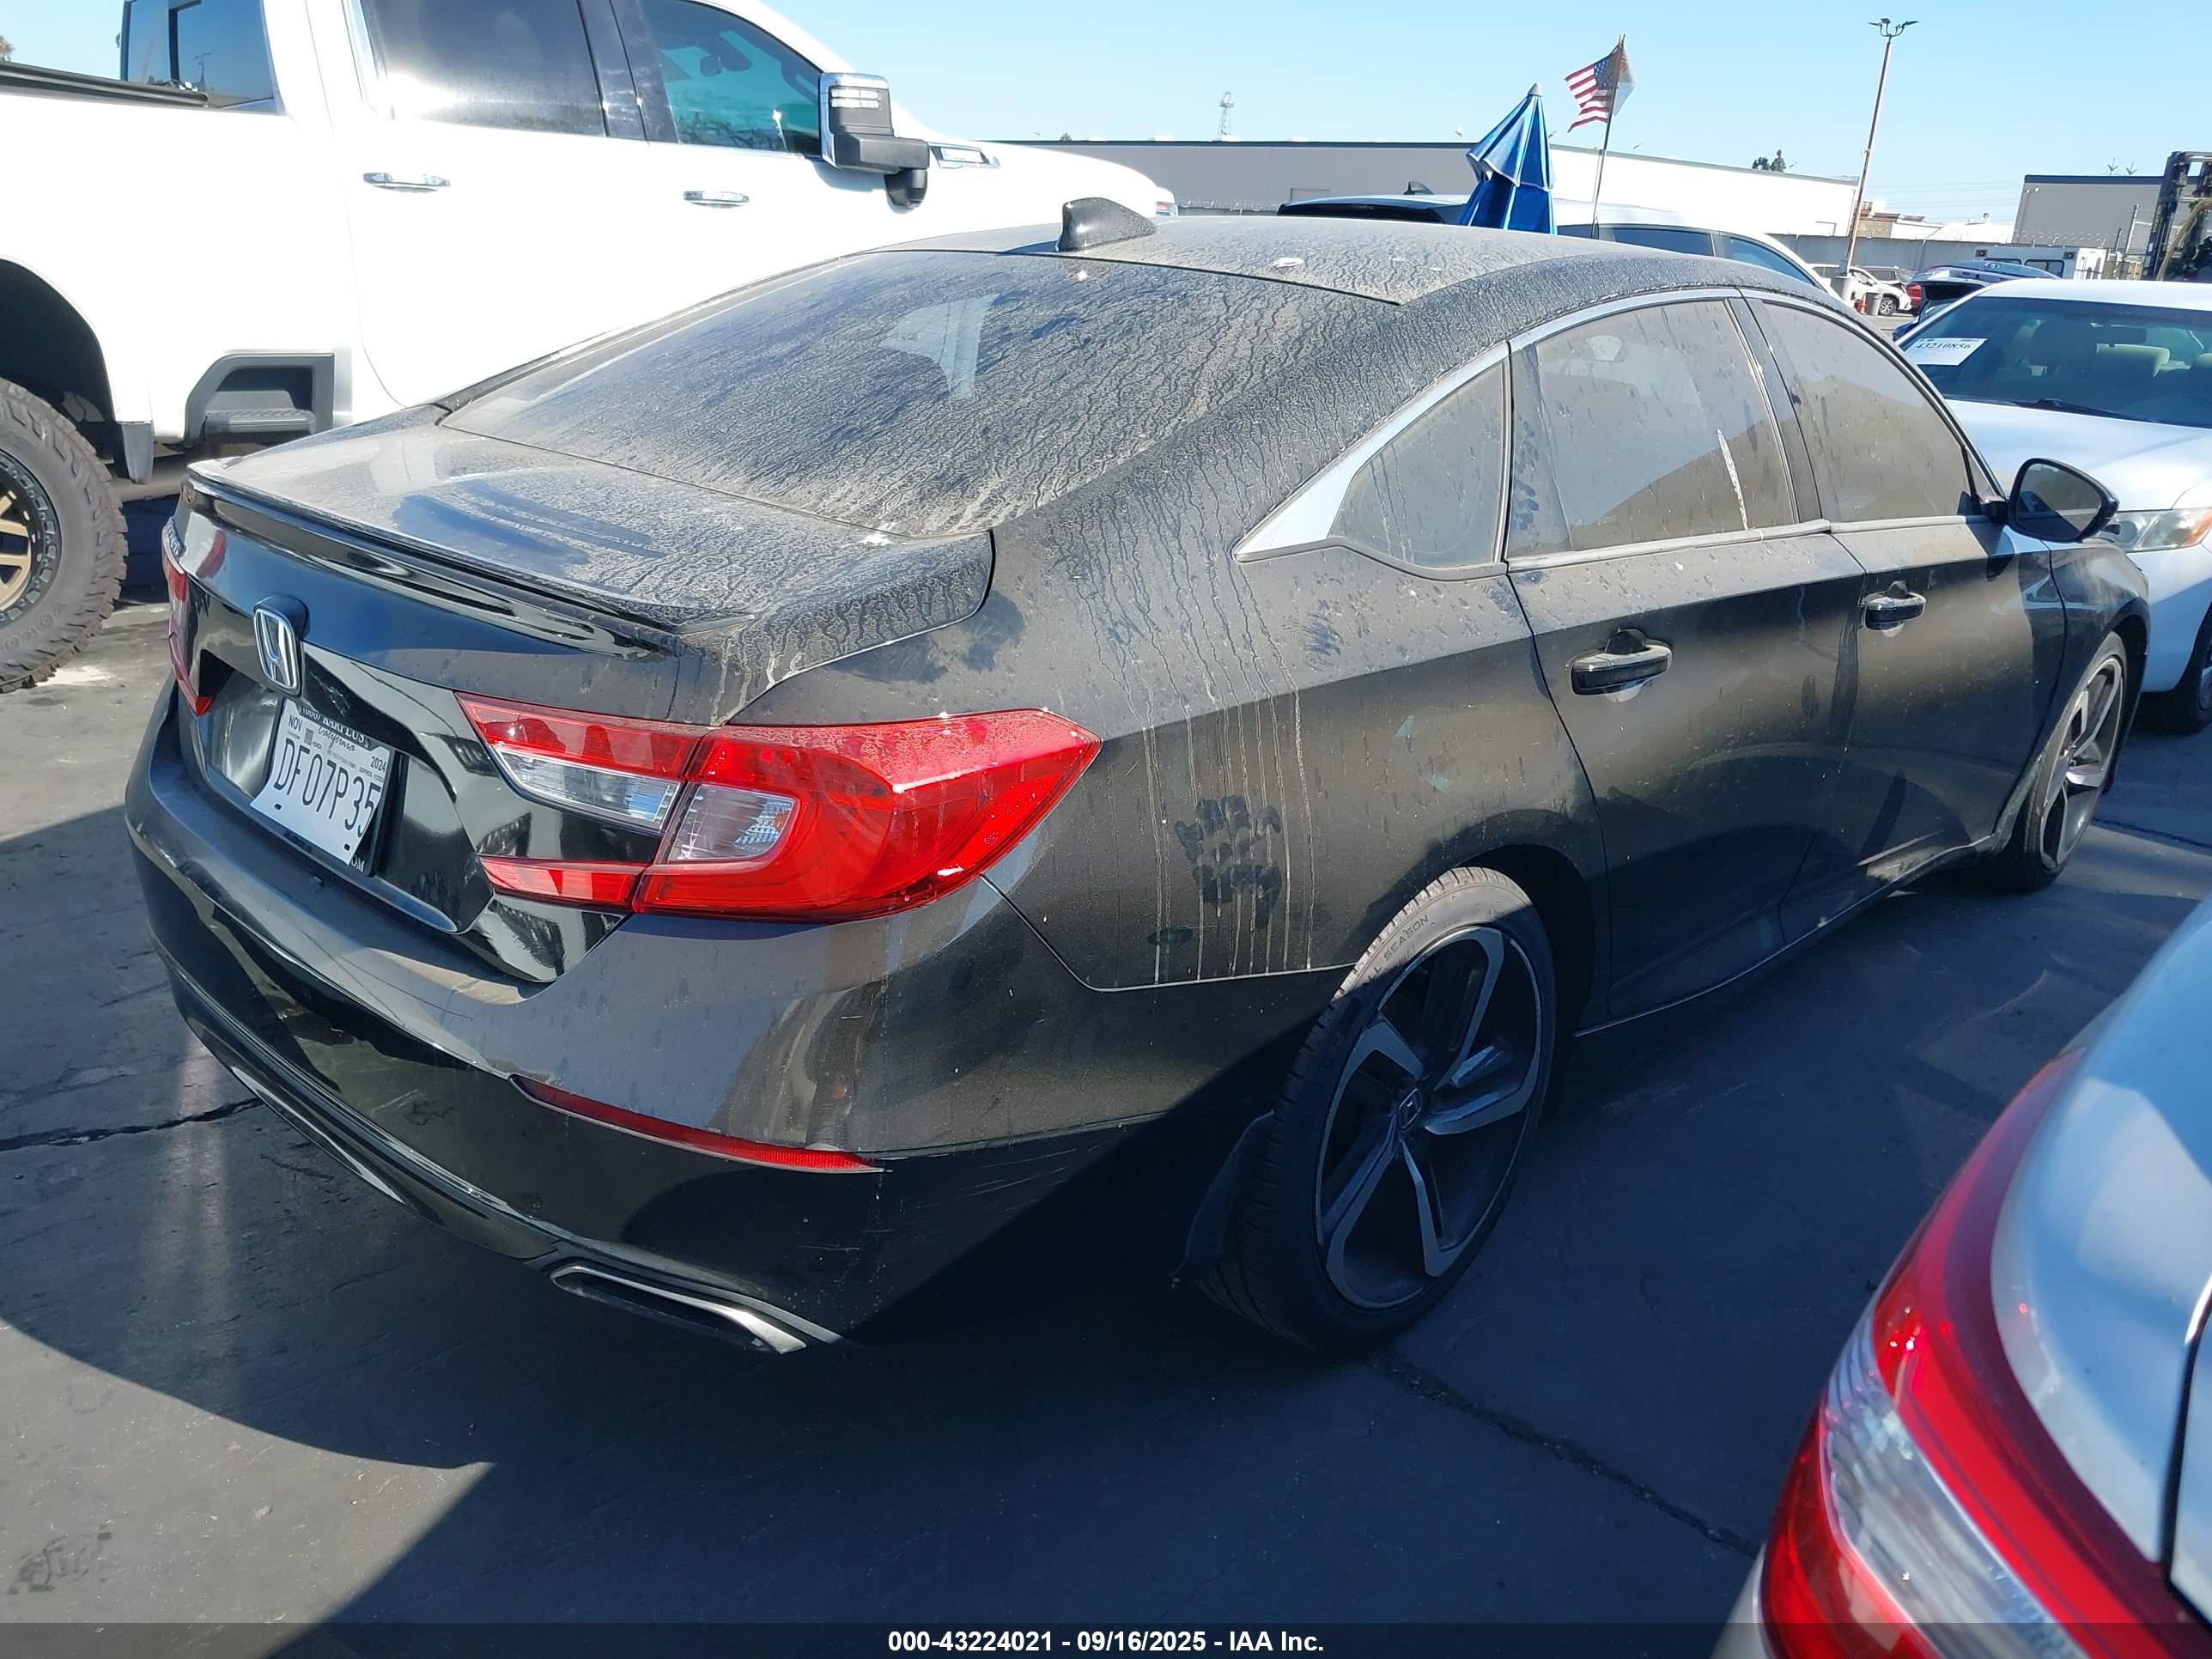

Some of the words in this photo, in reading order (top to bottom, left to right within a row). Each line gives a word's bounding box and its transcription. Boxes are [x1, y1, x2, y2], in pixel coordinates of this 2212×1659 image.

[288, 714, 302, 732] NOV
[370, 756, 386, 772] 2024
[273, 738, 382, 838] DF07P35
[1383, 915, 1430, 962] SEASON
